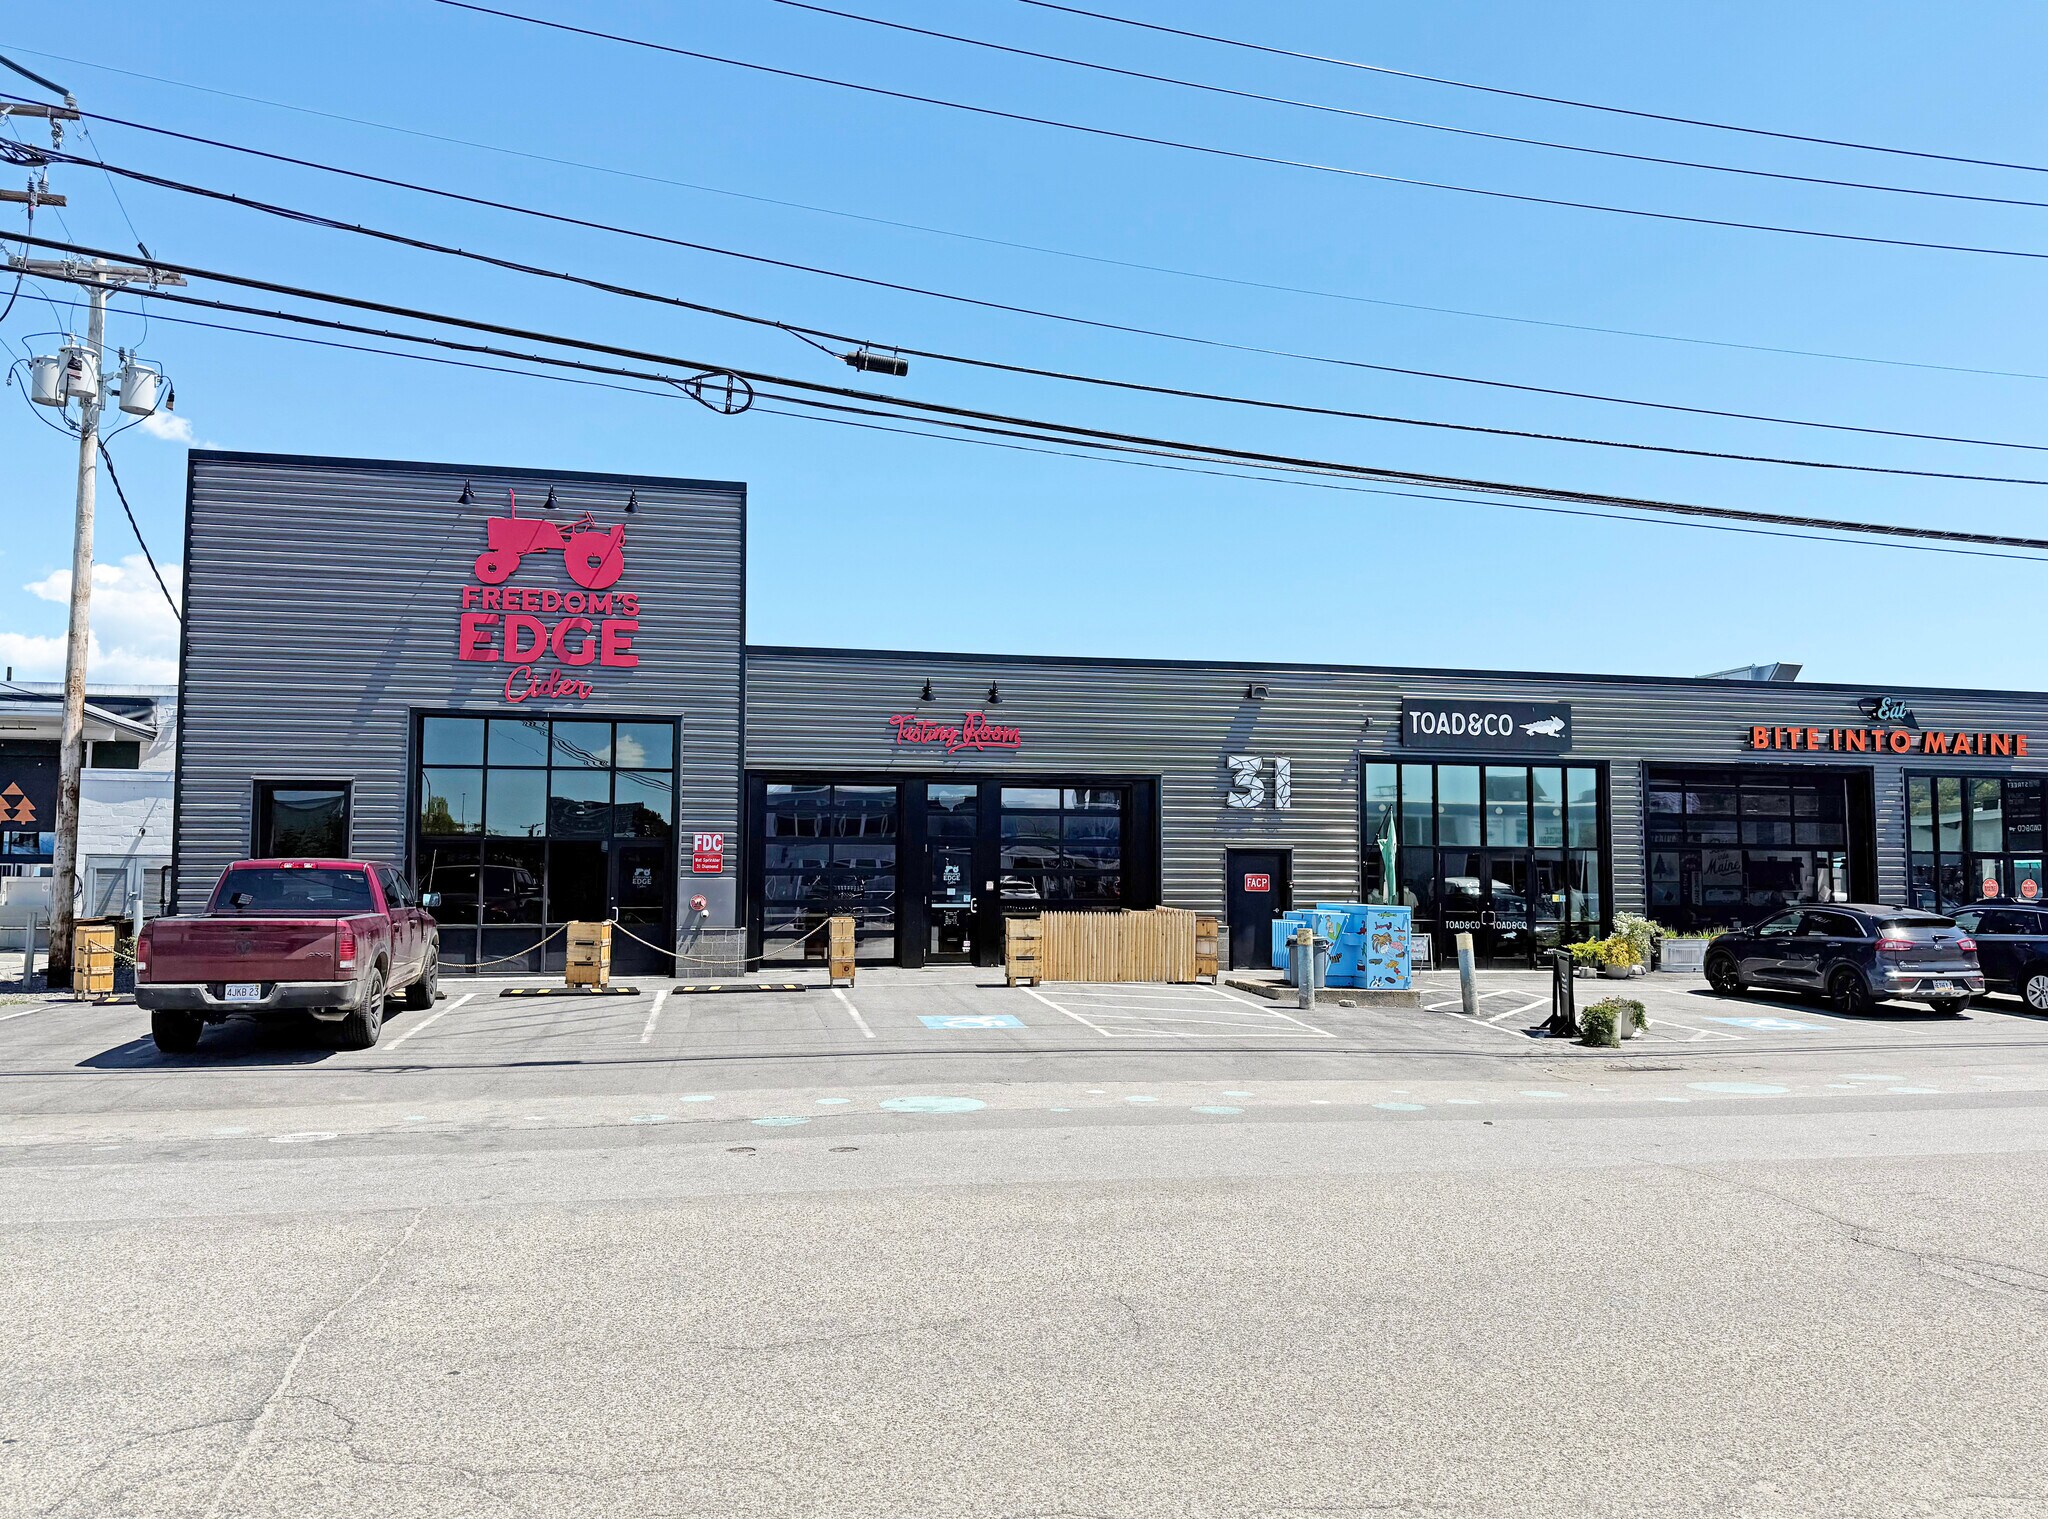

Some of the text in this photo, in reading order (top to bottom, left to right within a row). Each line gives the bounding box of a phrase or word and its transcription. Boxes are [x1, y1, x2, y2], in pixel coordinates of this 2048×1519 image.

[462, 585, 641, 616] FREEDOM'S
[458, 613, 639, 667] EDGE
[505, 665, 594, 703] Cider
[1877, 696, 1907, 721] Eat
[889, 711, 1022, 755] Tasting Room
[1409, 711, 1514, 736] TOAD&CO
[1751, 726, 2029, 756] BITE INTO MAINE
[1226, 755, 1291, 810] 31
[694, 834, 722, 851] FDC
[1703, 859, 1742, 876] Maine
[1246, 878, 1268, 888] FACP
[1445, 921, 1481, 930] TOAD&CO
[1492, 921, 1528, 930] TOAD&CO
